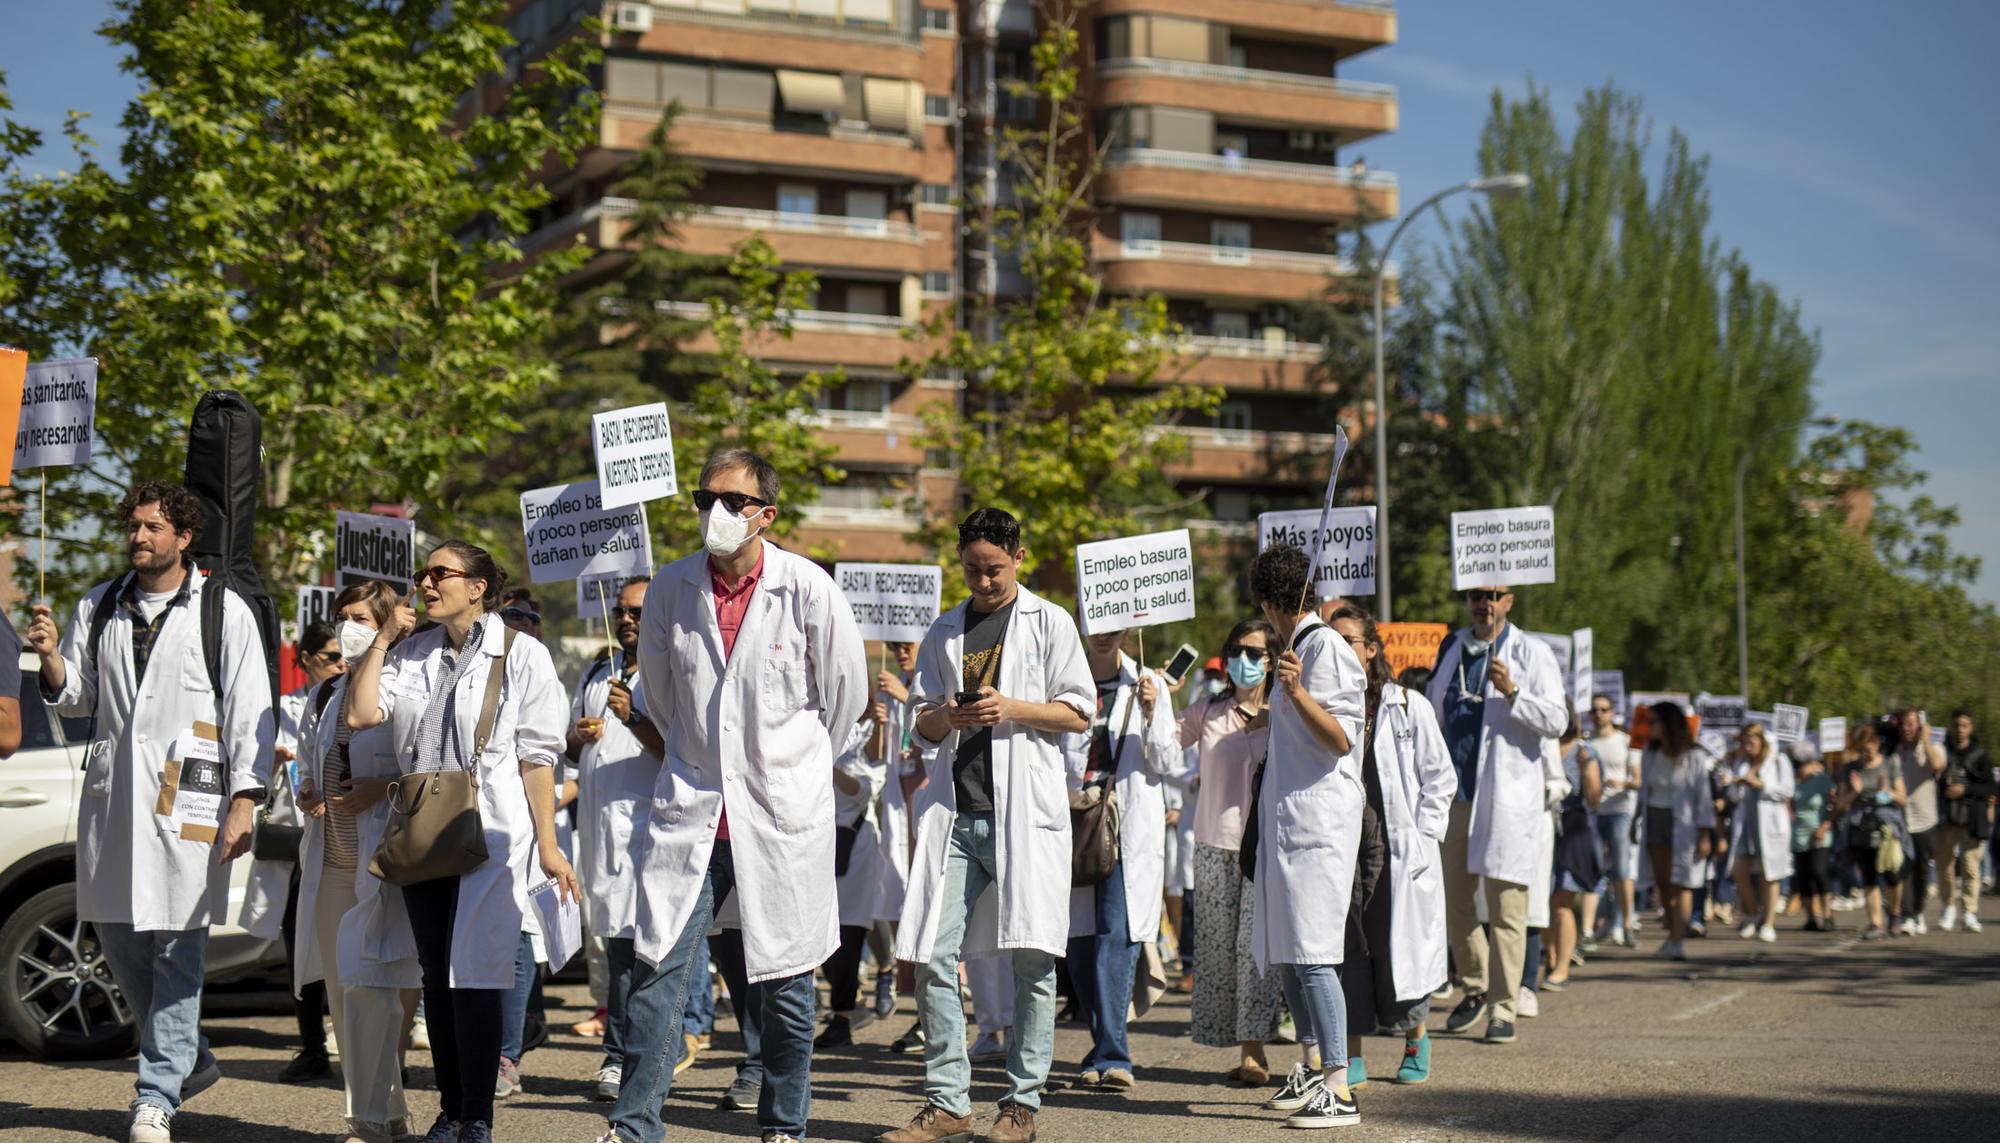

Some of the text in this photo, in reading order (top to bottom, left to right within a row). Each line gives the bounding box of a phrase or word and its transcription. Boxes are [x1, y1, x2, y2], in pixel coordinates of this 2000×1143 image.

[34, 373, 89, 404] sanitarios,
[15, 415, 91, 457] uy necesarios!
[601, 413, 667, 448] BASTA! RECUPEREMOS
[604, 451, 672, 488] NUESTROS DERECHOS!
[525, 499, 581, 520] Empleo
[527, 509, 643, 547] y poco personal
[1457, 519, 1551, 538] Empleo basura
[336, 521, 412, 580] ¡Justicia!
[532, 533, 644, 566] dañan tu salud.
[1083, 546, 1187, 575] Empleo basura
[1456, 536, 1553, 559] y poco personal
[1458, 554, 1552, 575] dañan tu salud.
[843, 570, 934, 595] BASTA! RECUPEREMOS
[1083, 565, 1191, 602] y poco personal
[1087, 588, 1191, 620] dañan tu salud.
[1384, 631, 1441, 647] AYUSO
